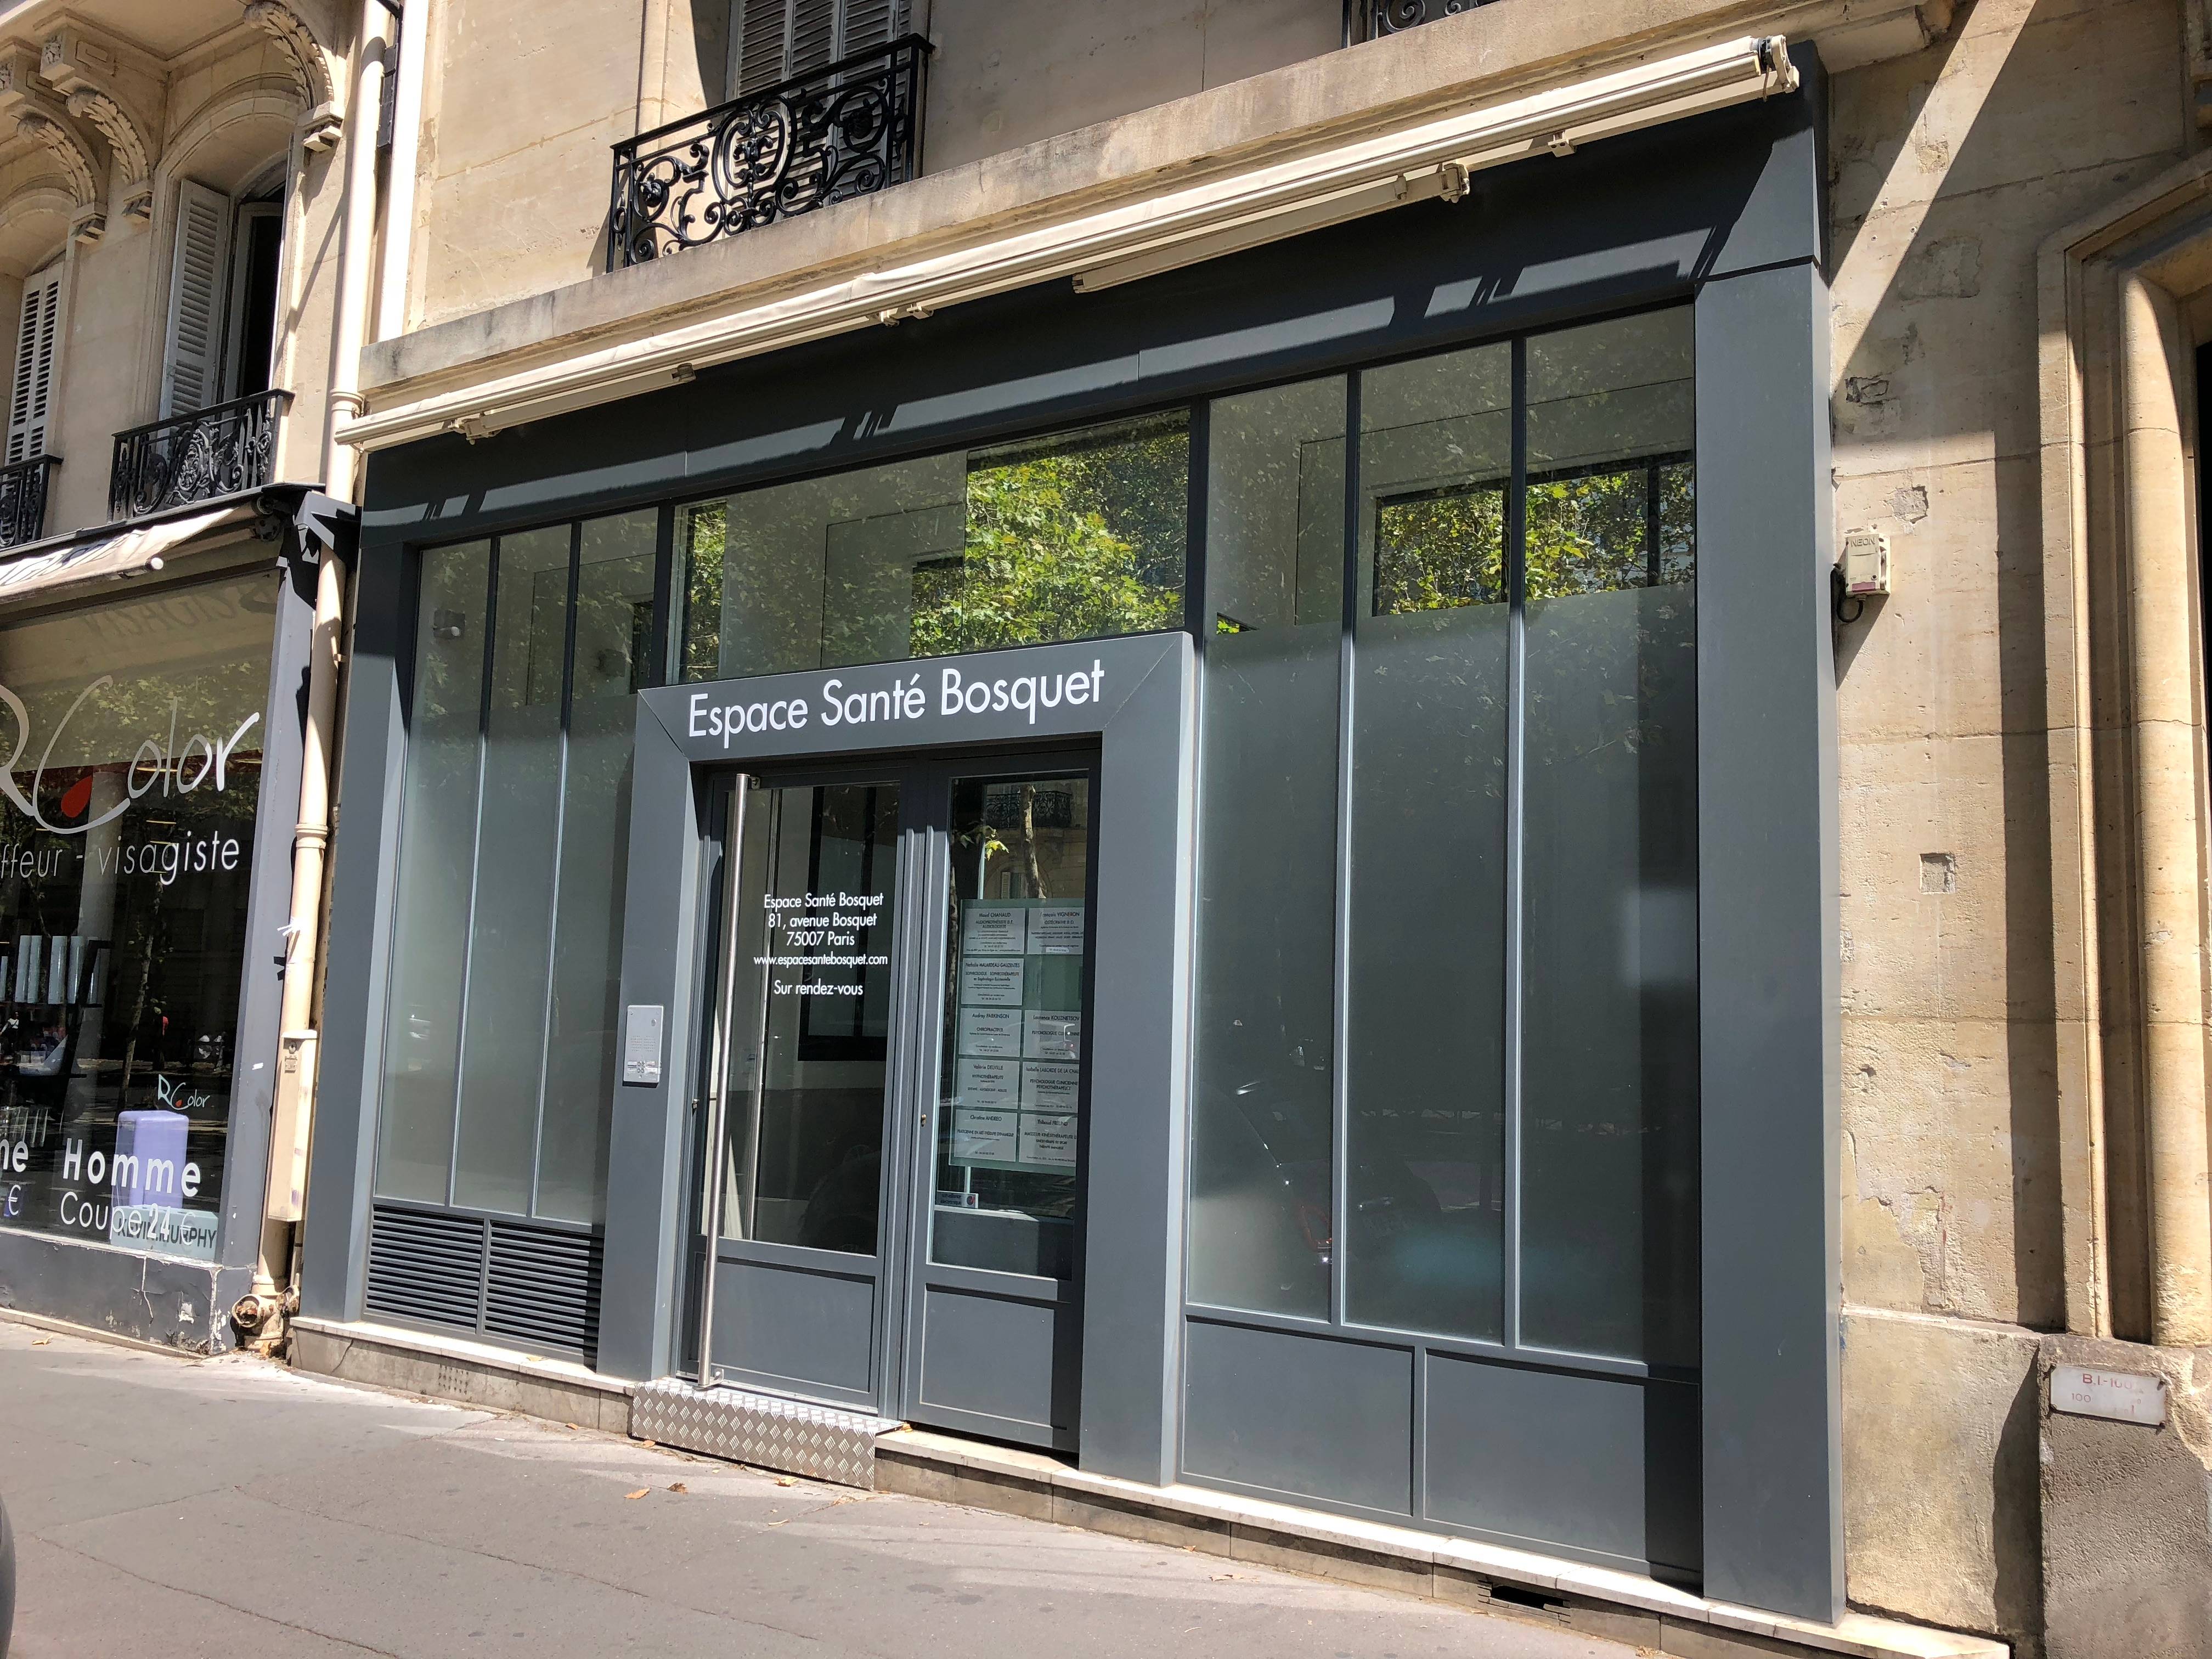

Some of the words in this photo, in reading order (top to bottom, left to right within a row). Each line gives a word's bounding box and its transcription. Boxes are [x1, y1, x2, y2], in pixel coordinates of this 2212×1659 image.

[1851, 538, 1875, 546] NEON
[689, 692, 808, 749] Espace
[820, 673, 926, 726] Santé
[941, 659, 1105, 725] Bosquet
[99, 830, 240, 885] visagiste
[764, 894, 801, 912] Espace
[805, 893, 836, 907] Santé
[839, 892, 884, 910] Bosquet
[769, 913, 786, 930] 81,
[790, 916, 829, 927] avenue
[833, 912, 877, 930] Bosquet
[786, 932, 825, 946] 75007
[828, 931, 855, 946] Paris
[754, 951, 888, 968] www.espacesantebosquet.com
[774, 980, 792, 995] Sur
[795, 978, 863, 995] rendez-vous
[63, 1137, 201, 1197] Homme
[60, 1191, 142, 1240] Coupe
[148, 1203, 171, 1240] 24
[180, 1211, 196, 1245] €
[2072, 1393, 2091, 1403] 100
